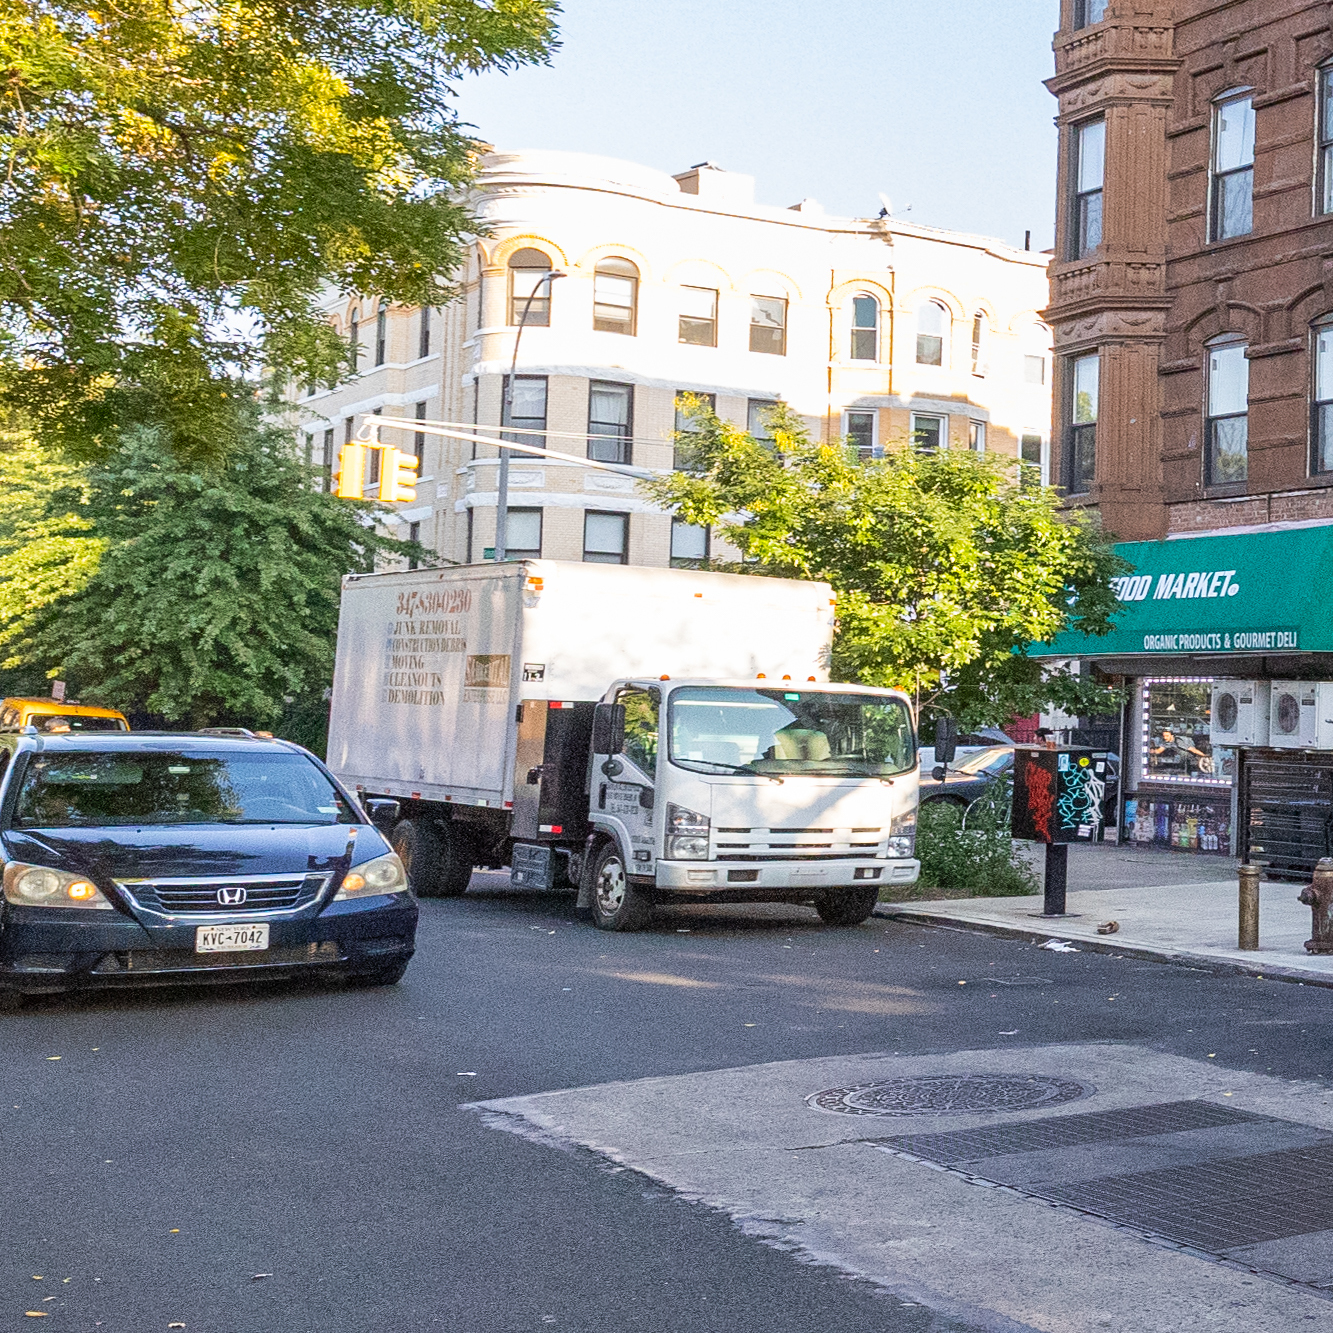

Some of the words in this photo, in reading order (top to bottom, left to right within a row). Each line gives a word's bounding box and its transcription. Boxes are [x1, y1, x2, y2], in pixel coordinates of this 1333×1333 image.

[394, 621, 416, 635] JUNK
[419, 620, 461, 635] REMOVAL
[1143, 634, 1178, 650] ORGANIC
[1179, 633, 1221, 649] PRODUCTS
[1223, 633, 1231, 649] &
[1233, 632, 1276, 649] GOURMET
[1277, 631, 1298, 648] DELI
[392, 654, 425, 670] MOVING
[389, 672, 442, 687] CLEANOUTS
[388, 688, 446, 706] DEMOLITION
